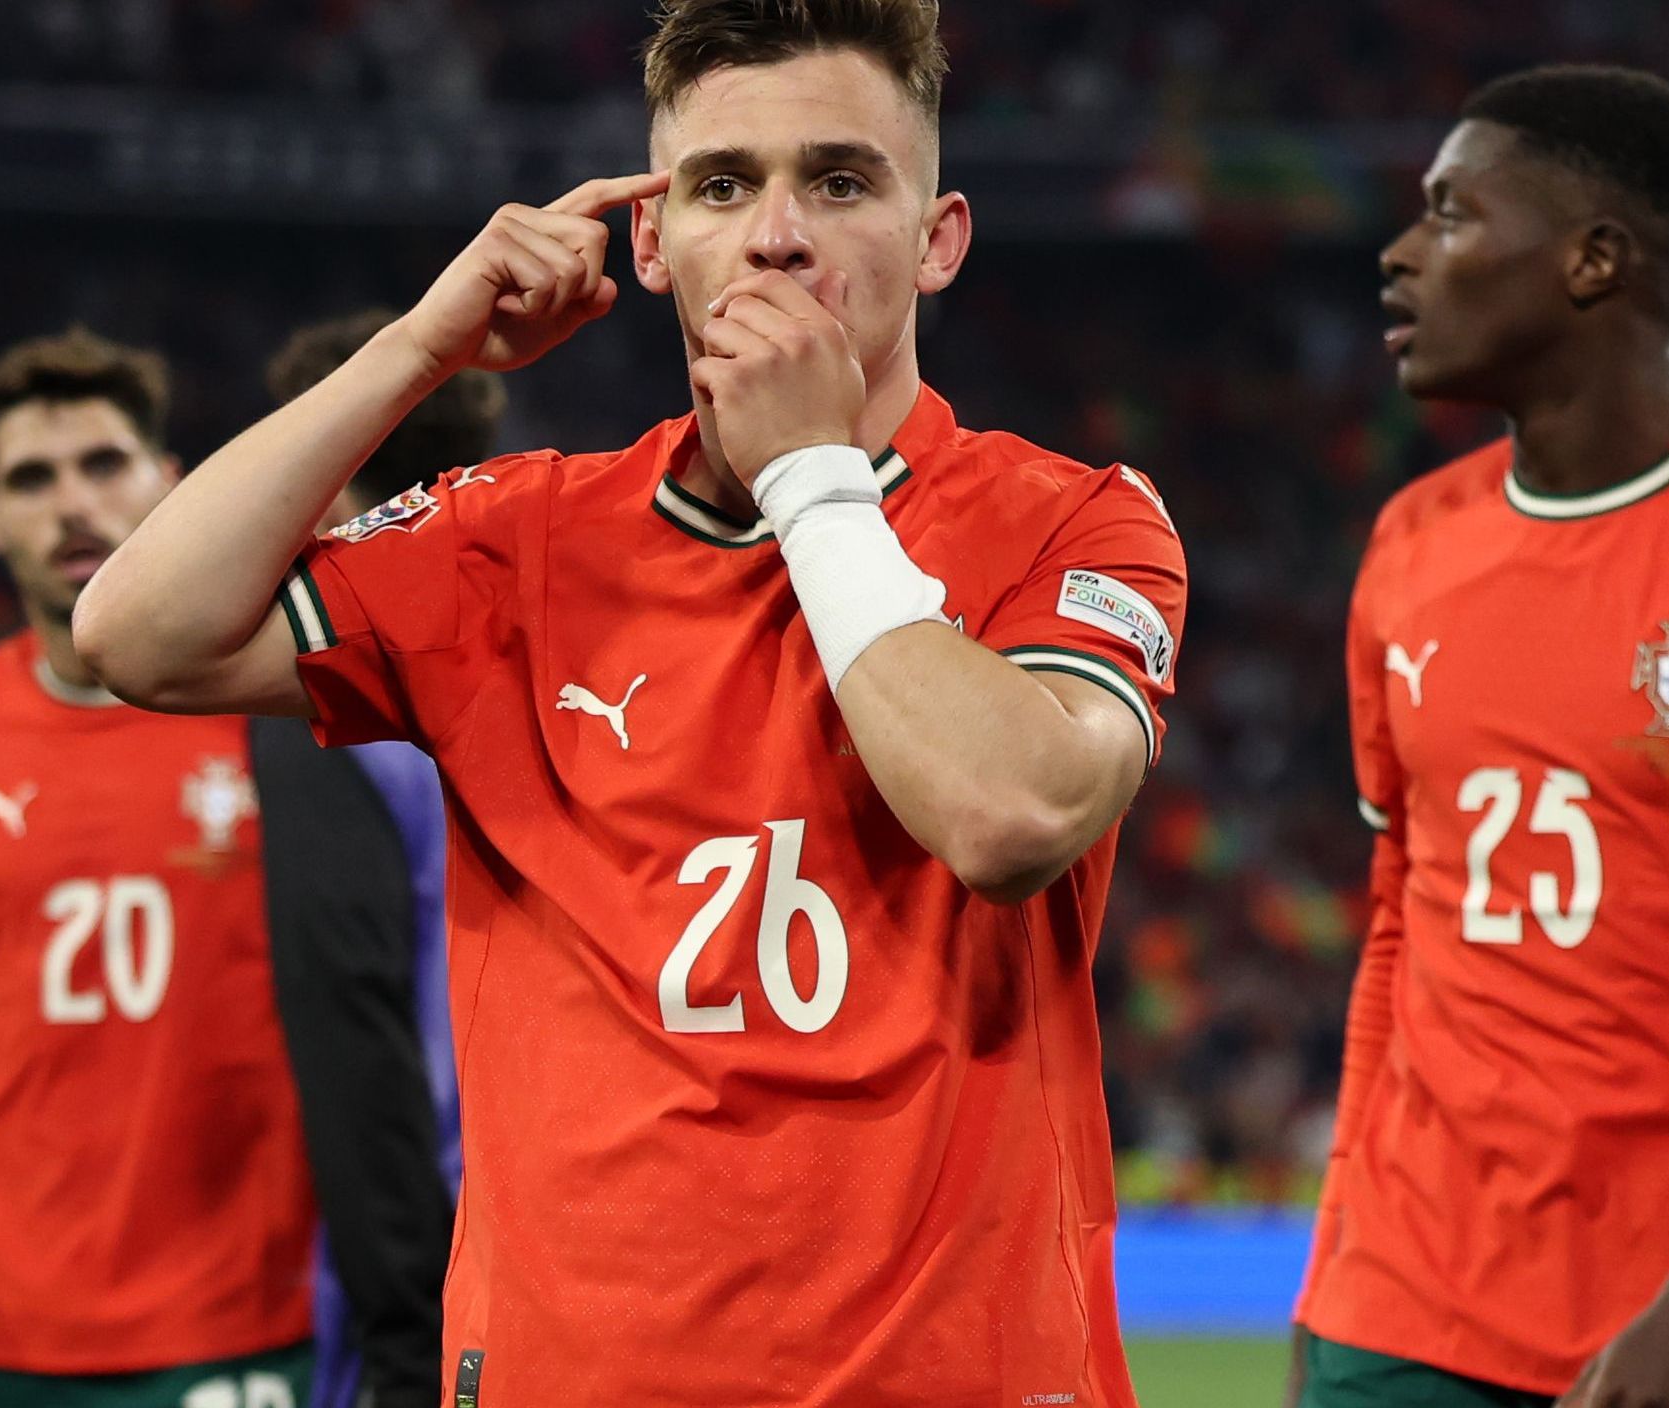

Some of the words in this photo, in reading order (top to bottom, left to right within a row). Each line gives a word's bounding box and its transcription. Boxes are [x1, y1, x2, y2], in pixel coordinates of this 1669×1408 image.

[1069, 572, 1099, 586] UEFA
[658, 818, 849, 1034] 26
[1457, 767, 1604, 949] 25
[41, 874, 176, 1024] 20
